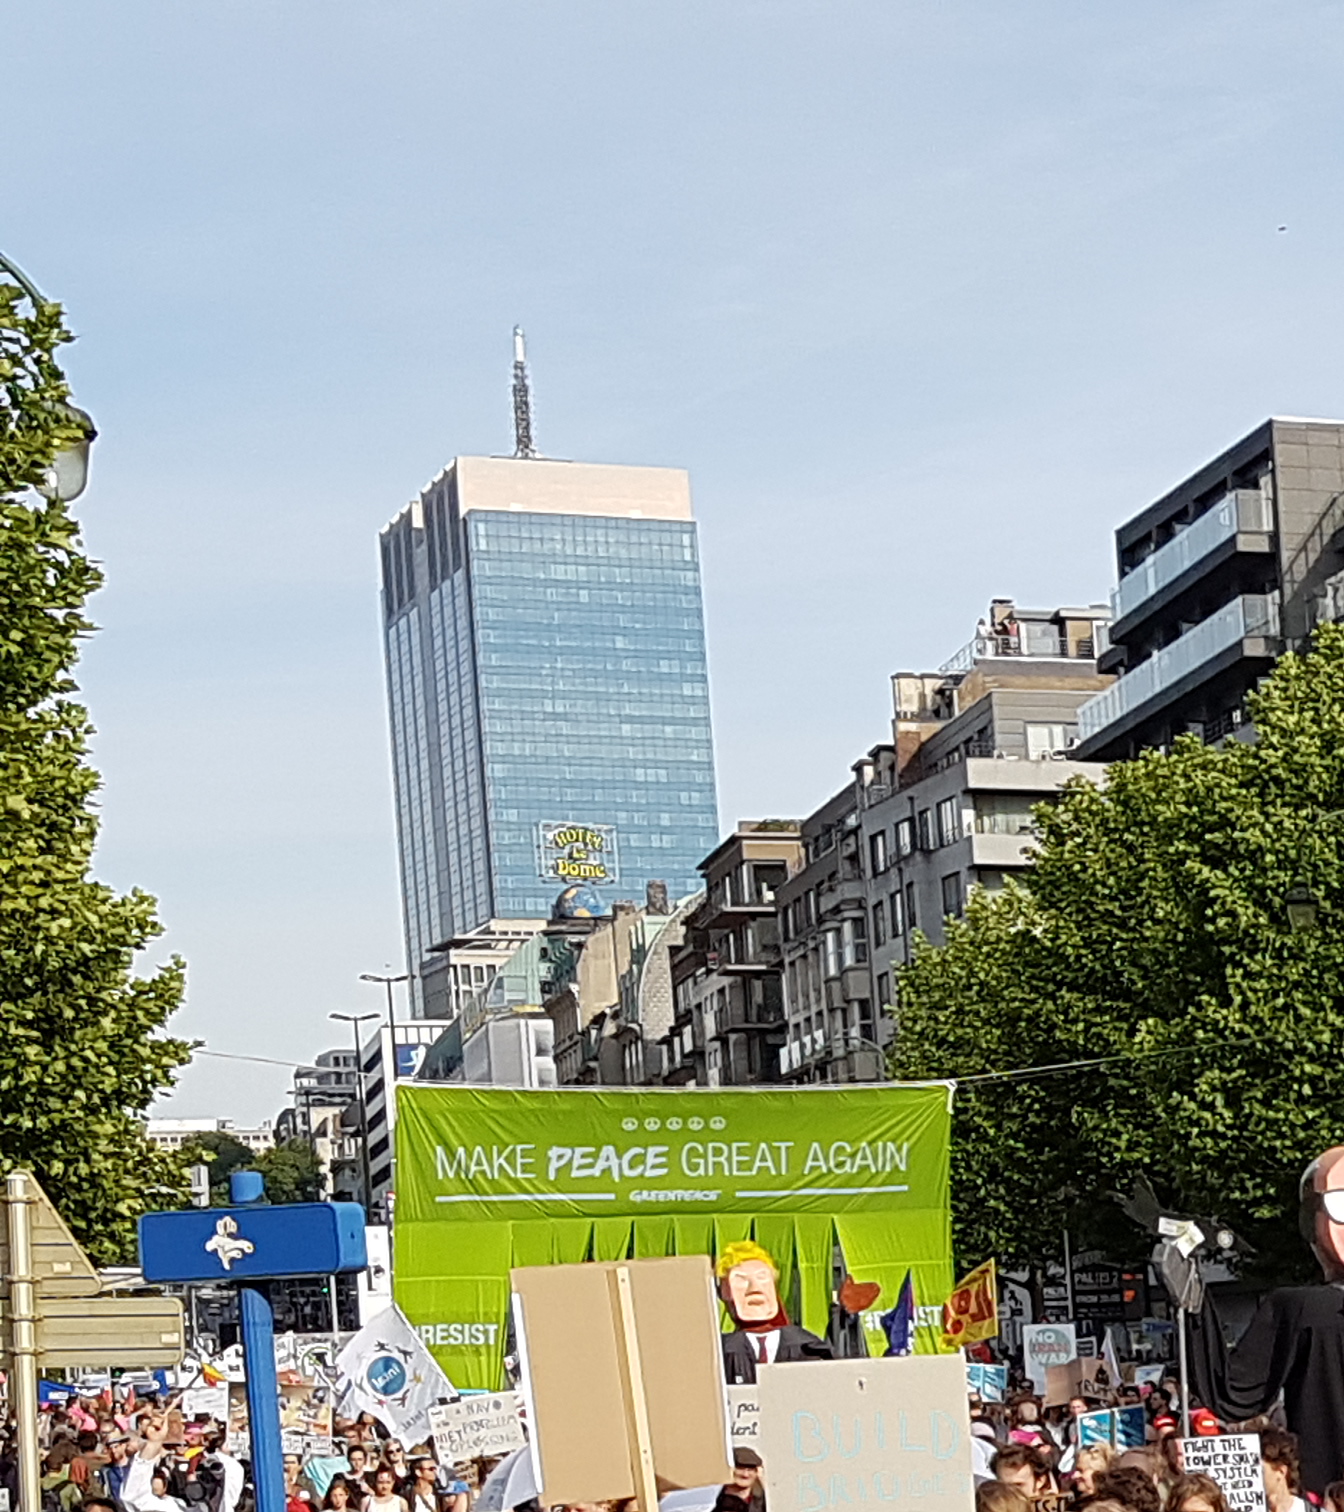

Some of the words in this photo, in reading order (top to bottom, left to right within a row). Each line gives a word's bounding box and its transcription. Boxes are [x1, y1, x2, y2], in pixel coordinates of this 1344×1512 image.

[434, 1144, 536, 1180] MAKE
[547, 1144, 669, 1181] PEACE
[681, 1142, 793, 1176] GREAT
[804, 1141, 909, 1174] AGAIN
[1031, 1331, 1055, 1342] NO
[792, 1409, 960, 1462] BUILD
[1183, 1439, 1216, 1453] FIGHT
[1220, 1437, 1247, 1451] THE
[1185, 1454, 1229, 1468] POWER
[1214, 1466, 1258, 1479] SYSTEM
[1228, 1491, 1264, 1506] ALISM
